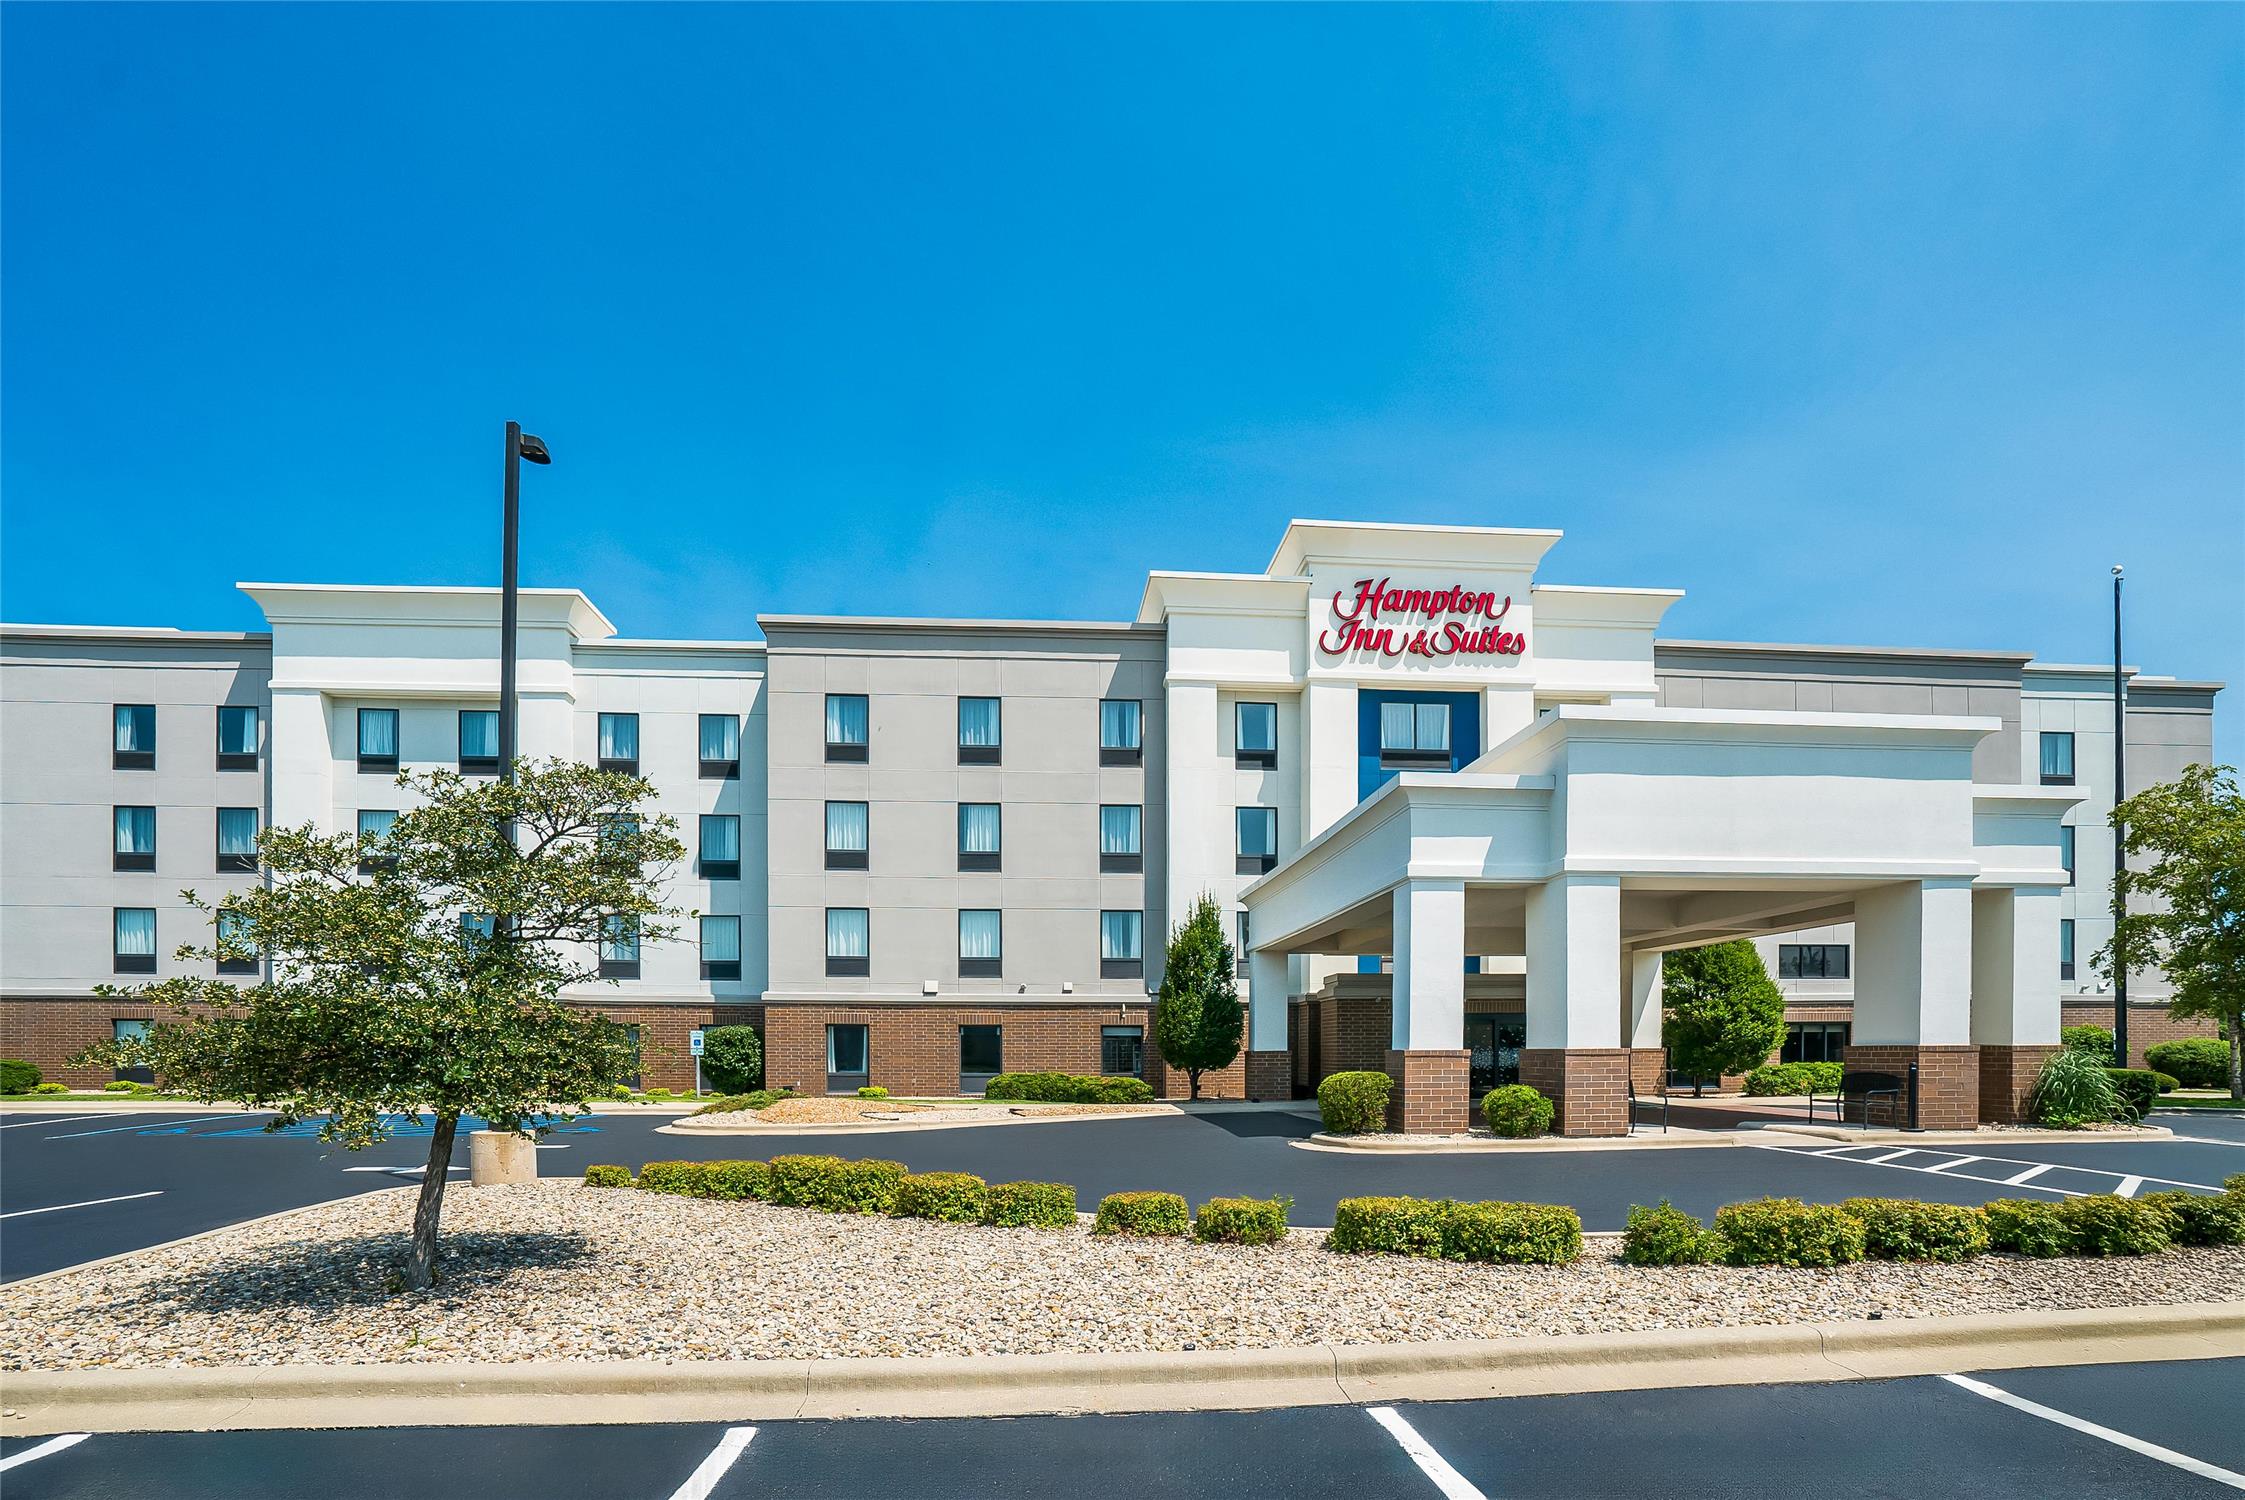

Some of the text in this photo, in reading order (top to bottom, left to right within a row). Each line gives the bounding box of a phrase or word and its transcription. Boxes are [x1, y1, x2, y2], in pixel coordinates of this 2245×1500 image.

[1333, 577, 1511, 620] Hampton
[1320, 619, 1526, 658] Inn & Suites
